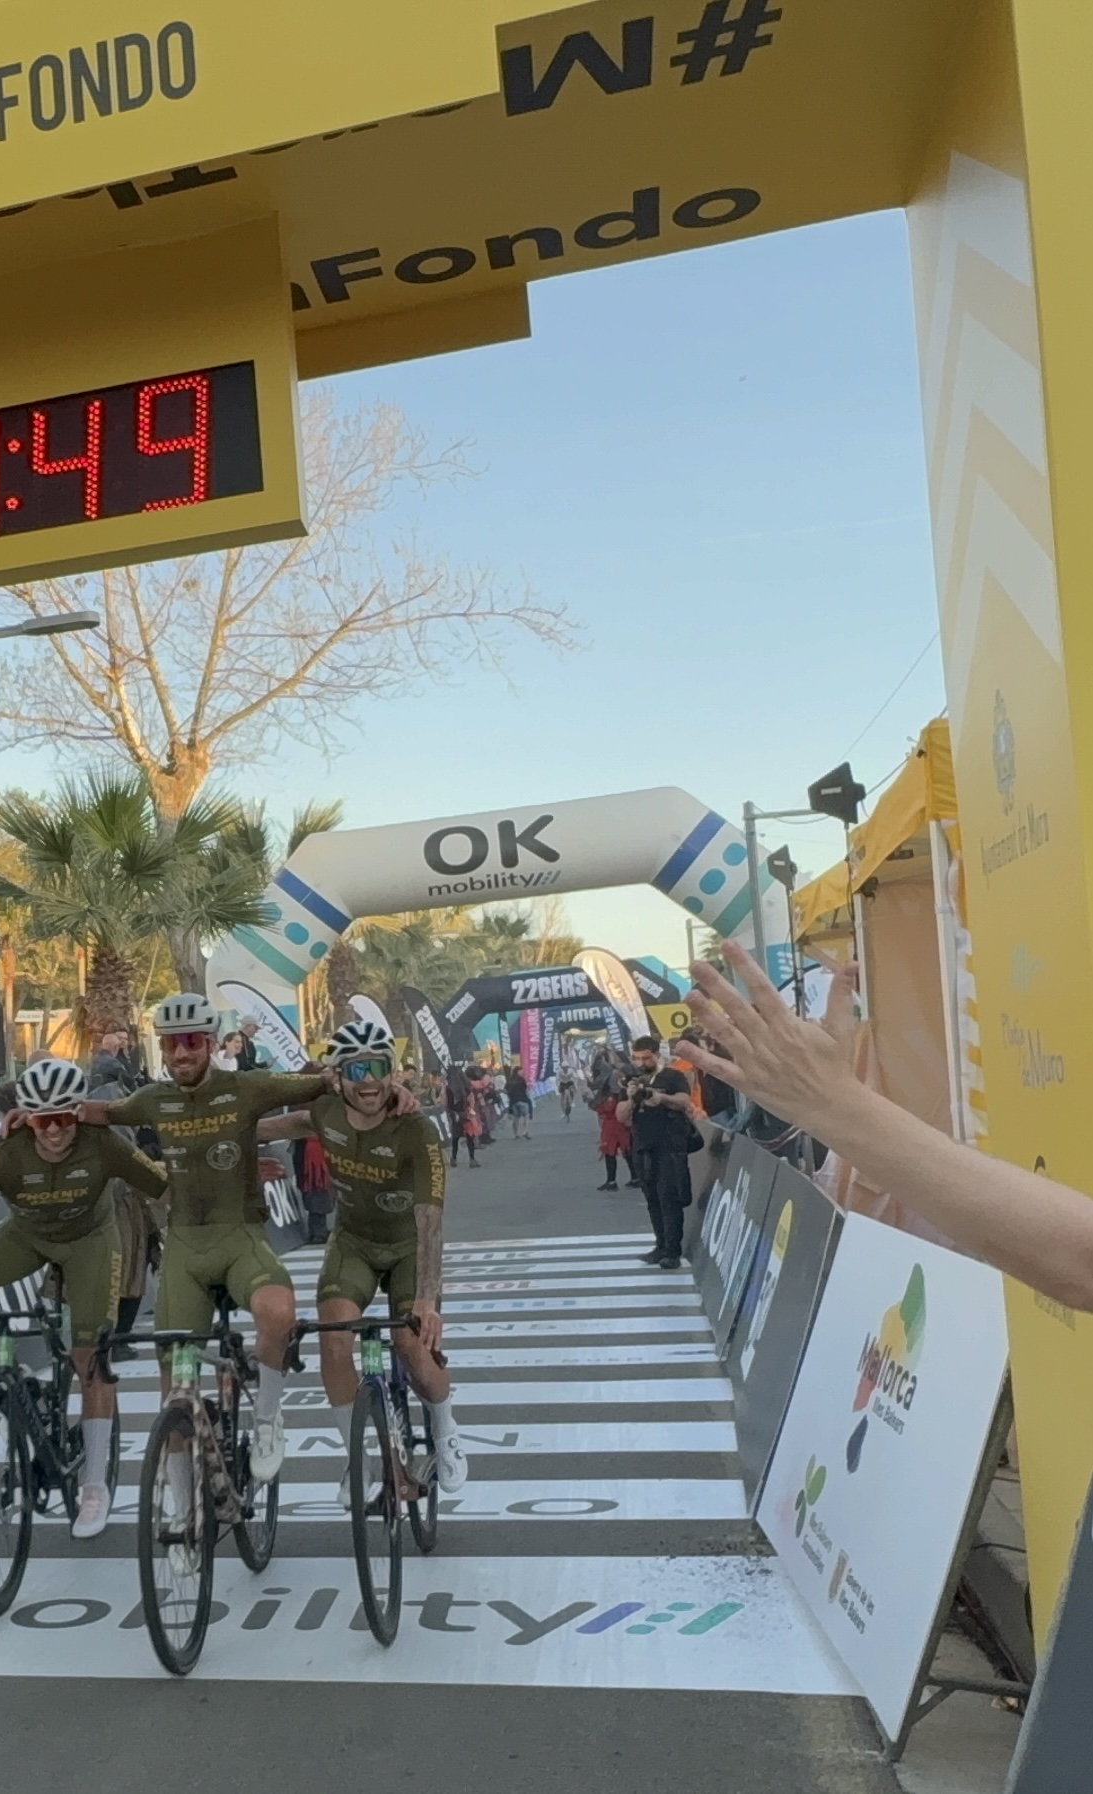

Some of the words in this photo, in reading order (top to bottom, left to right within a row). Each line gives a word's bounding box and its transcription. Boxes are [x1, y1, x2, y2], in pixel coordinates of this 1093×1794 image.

[423, 814, 561, 876] OK
[428, 872, 535, 897] mobility
[510, 972, 589, 1004] 226ERS
[158, 1112, 238, 1132] PHOENIX
[304, 1149, 399, 1180] PHOENIX
[426, 1143, 445, 1200] PHOENIX
[16, 1187, 89, 1201] PHOENIX
[856, 1331, 918, 1412] Mallorca
